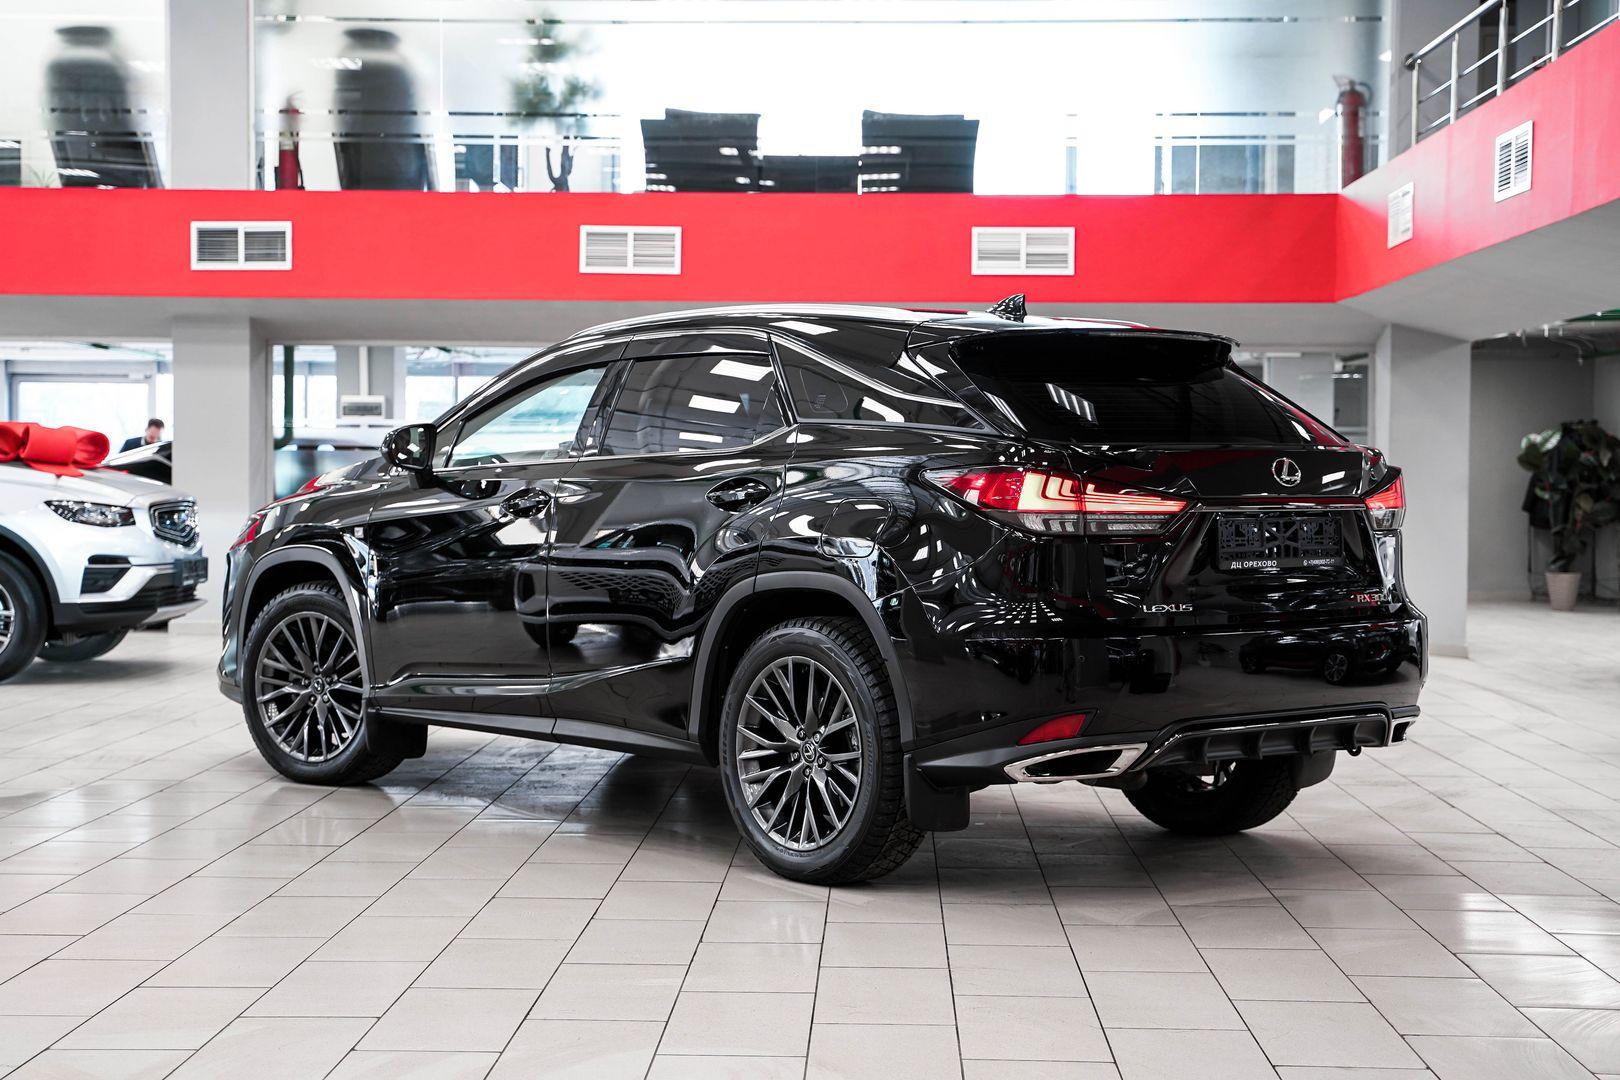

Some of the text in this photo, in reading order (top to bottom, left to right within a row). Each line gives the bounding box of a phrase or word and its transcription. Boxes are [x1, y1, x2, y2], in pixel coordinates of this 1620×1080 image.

[1230, 560, 1278, 570] ДЦ ОРЕХОВО
[1143, 603, 1193, 613] LEXUS
